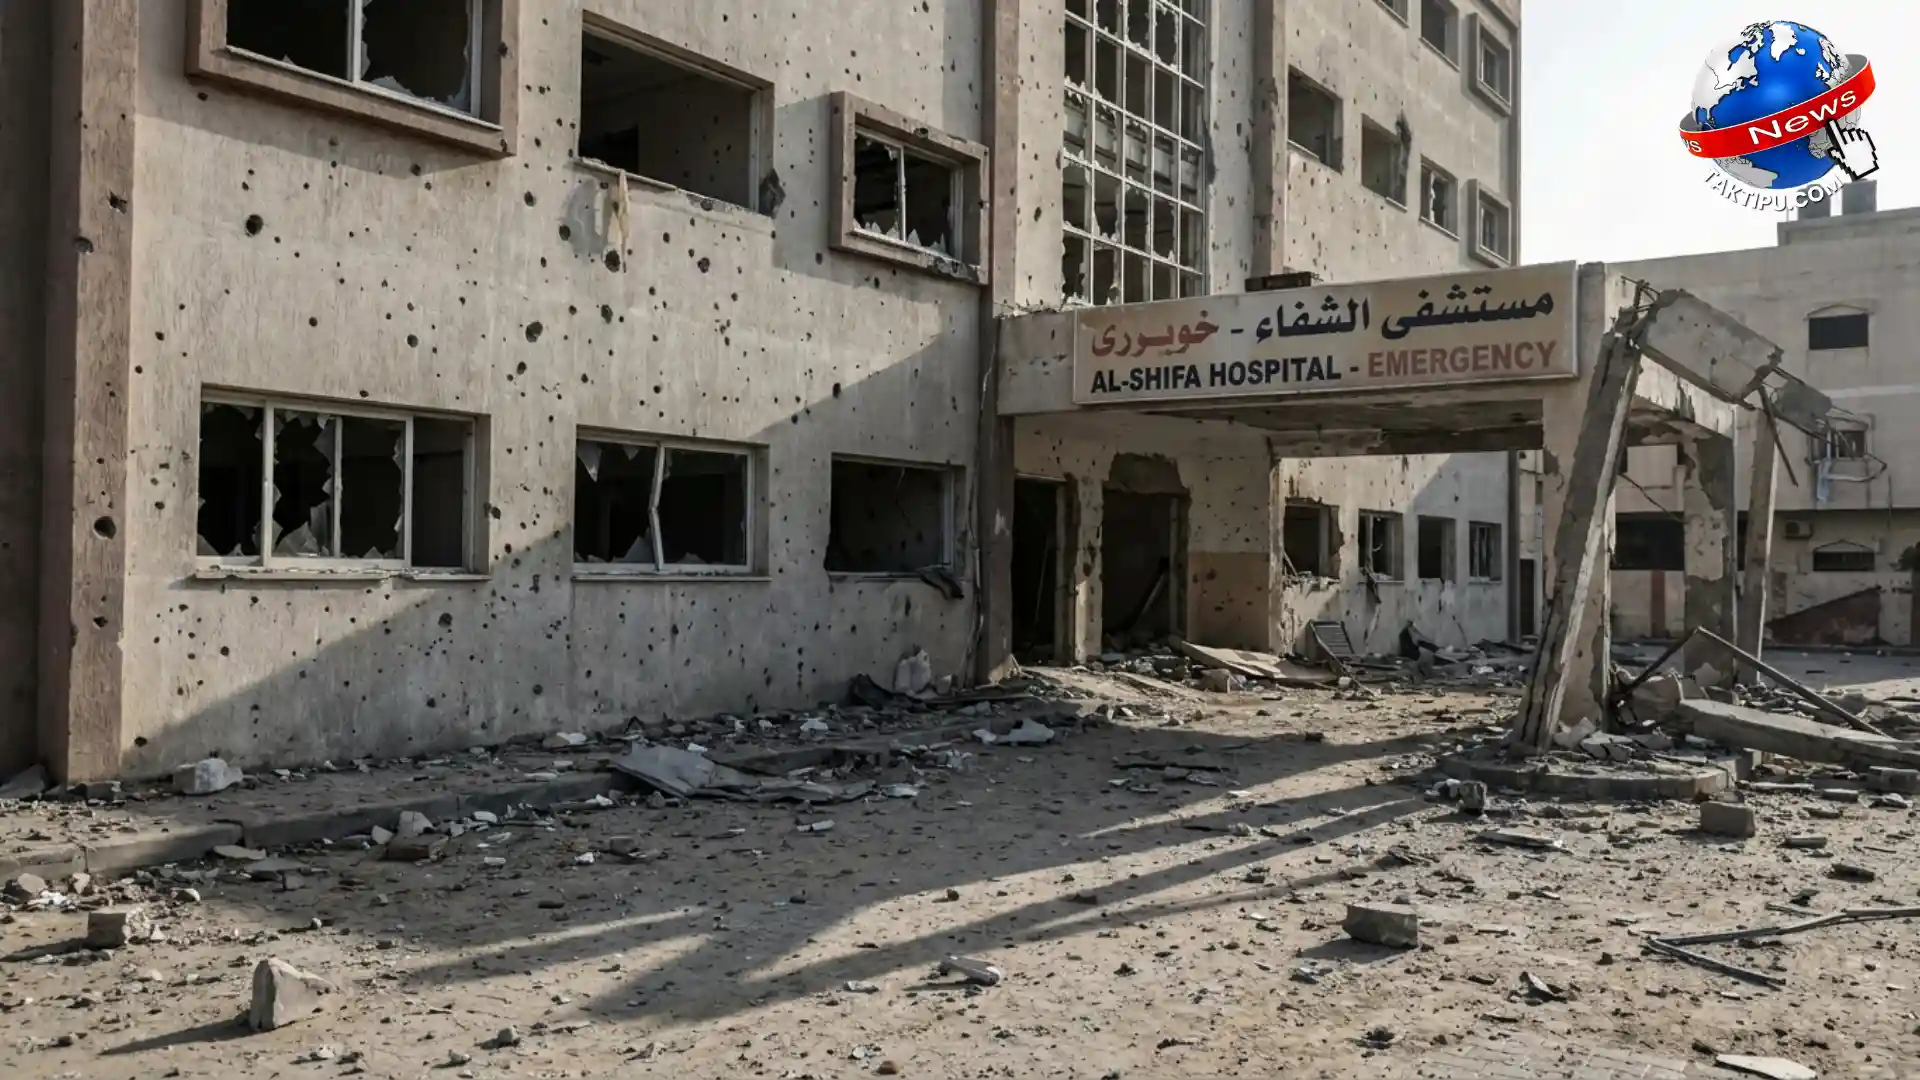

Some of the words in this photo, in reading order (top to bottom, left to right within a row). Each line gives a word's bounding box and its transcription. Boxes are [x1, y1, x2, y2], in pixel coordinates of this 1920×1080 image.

[1256, 295, 1370, 343] الشفاء
[1382, 284, 1554, 339] مستشفى
[1091, 364, 1201, 393] AL-SHIFA
[1210, 355, 1341, 386] HOSPITAL
[1368, 340, 1557, 377] EMERGENCY
